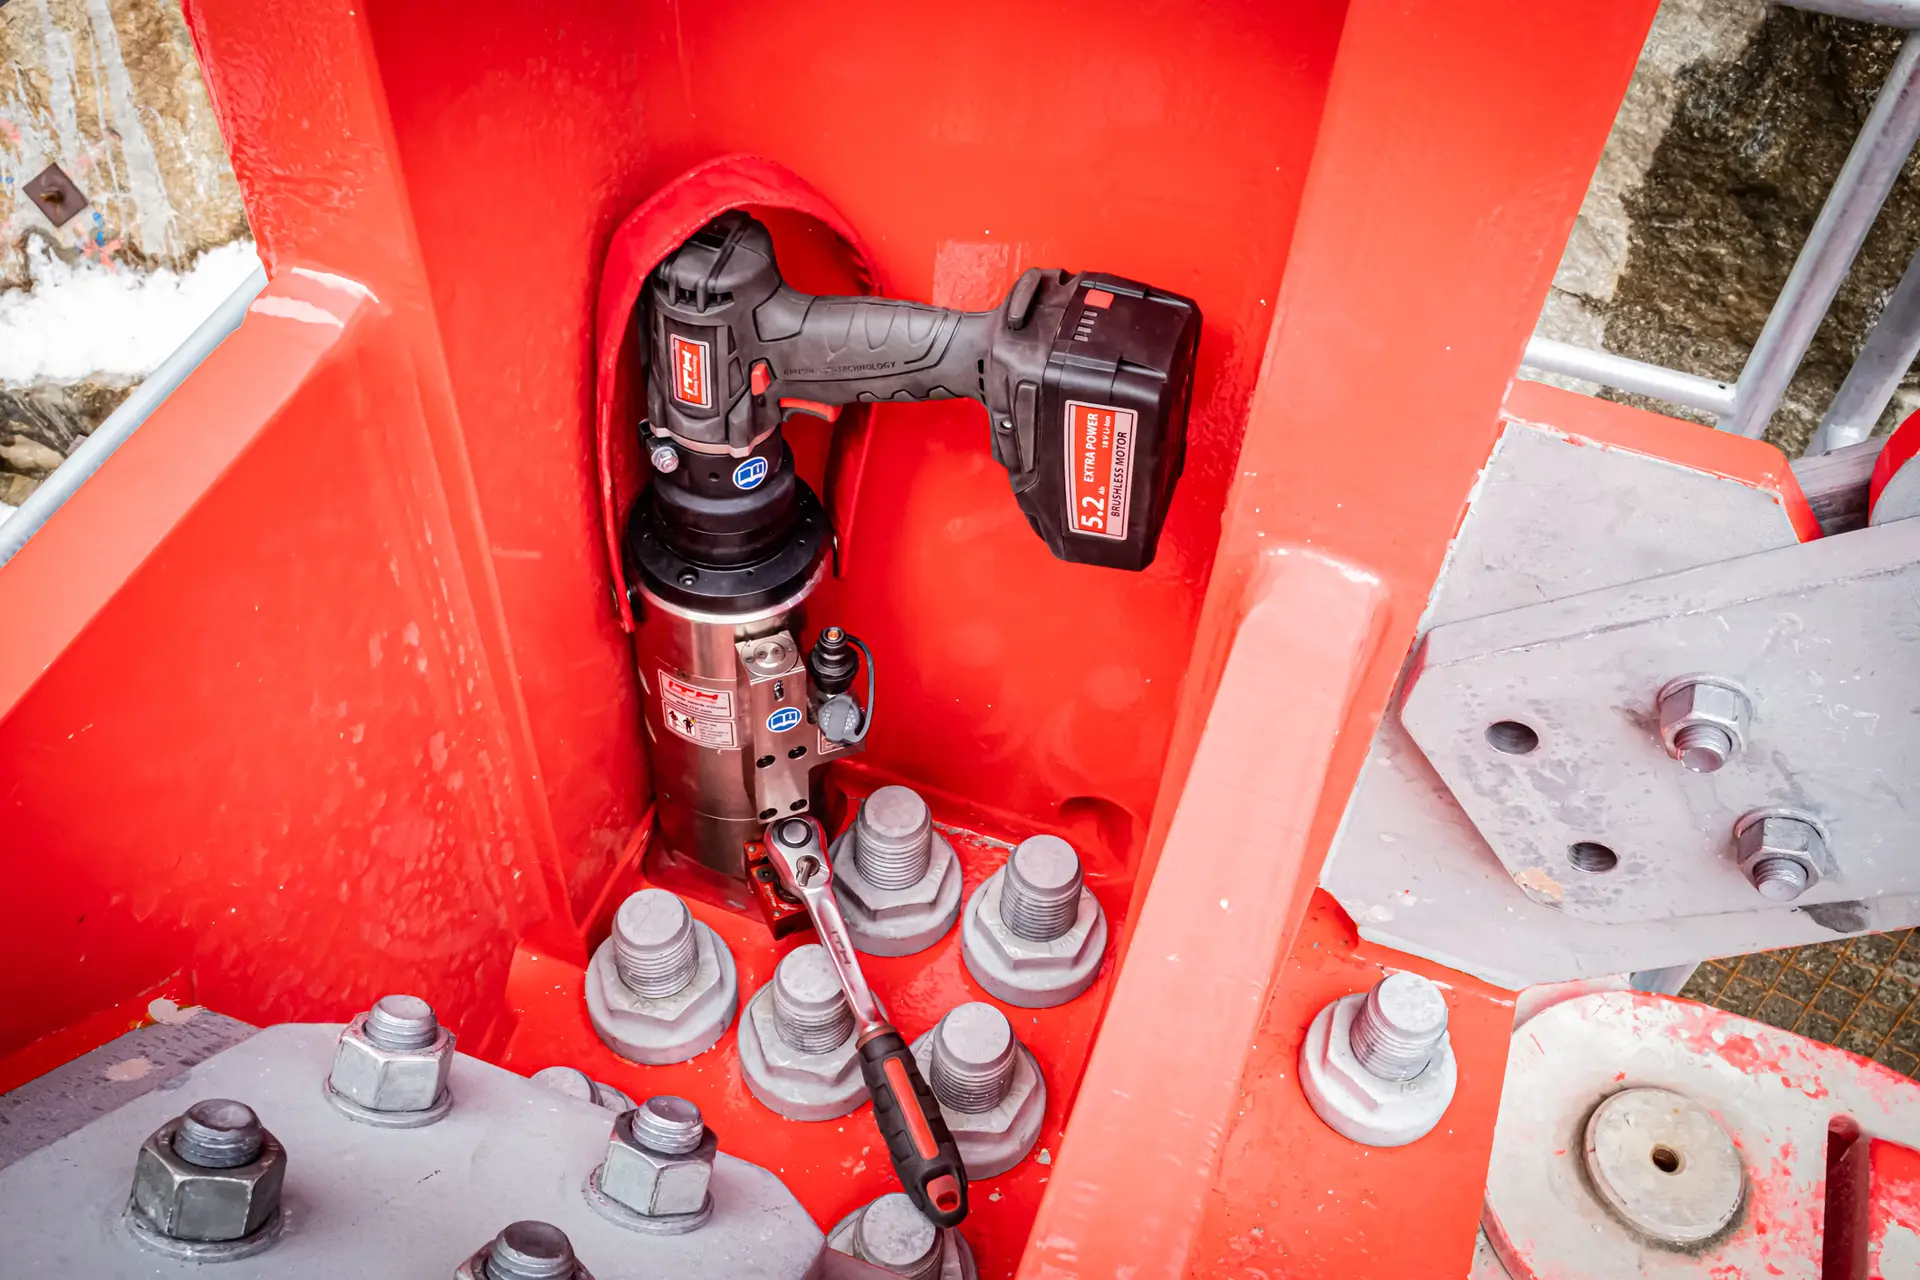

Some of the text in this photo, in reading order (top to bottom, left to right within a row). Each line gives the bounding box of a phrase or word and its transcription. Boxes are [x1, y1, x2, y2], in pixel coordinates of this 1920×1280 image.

[1083, 413, 1099, 483] EXTRA POWER
[1111, 431, 1127, 518] BRUSHLESS MOTOR
[1081, 496, 1105, 529] 5.2
